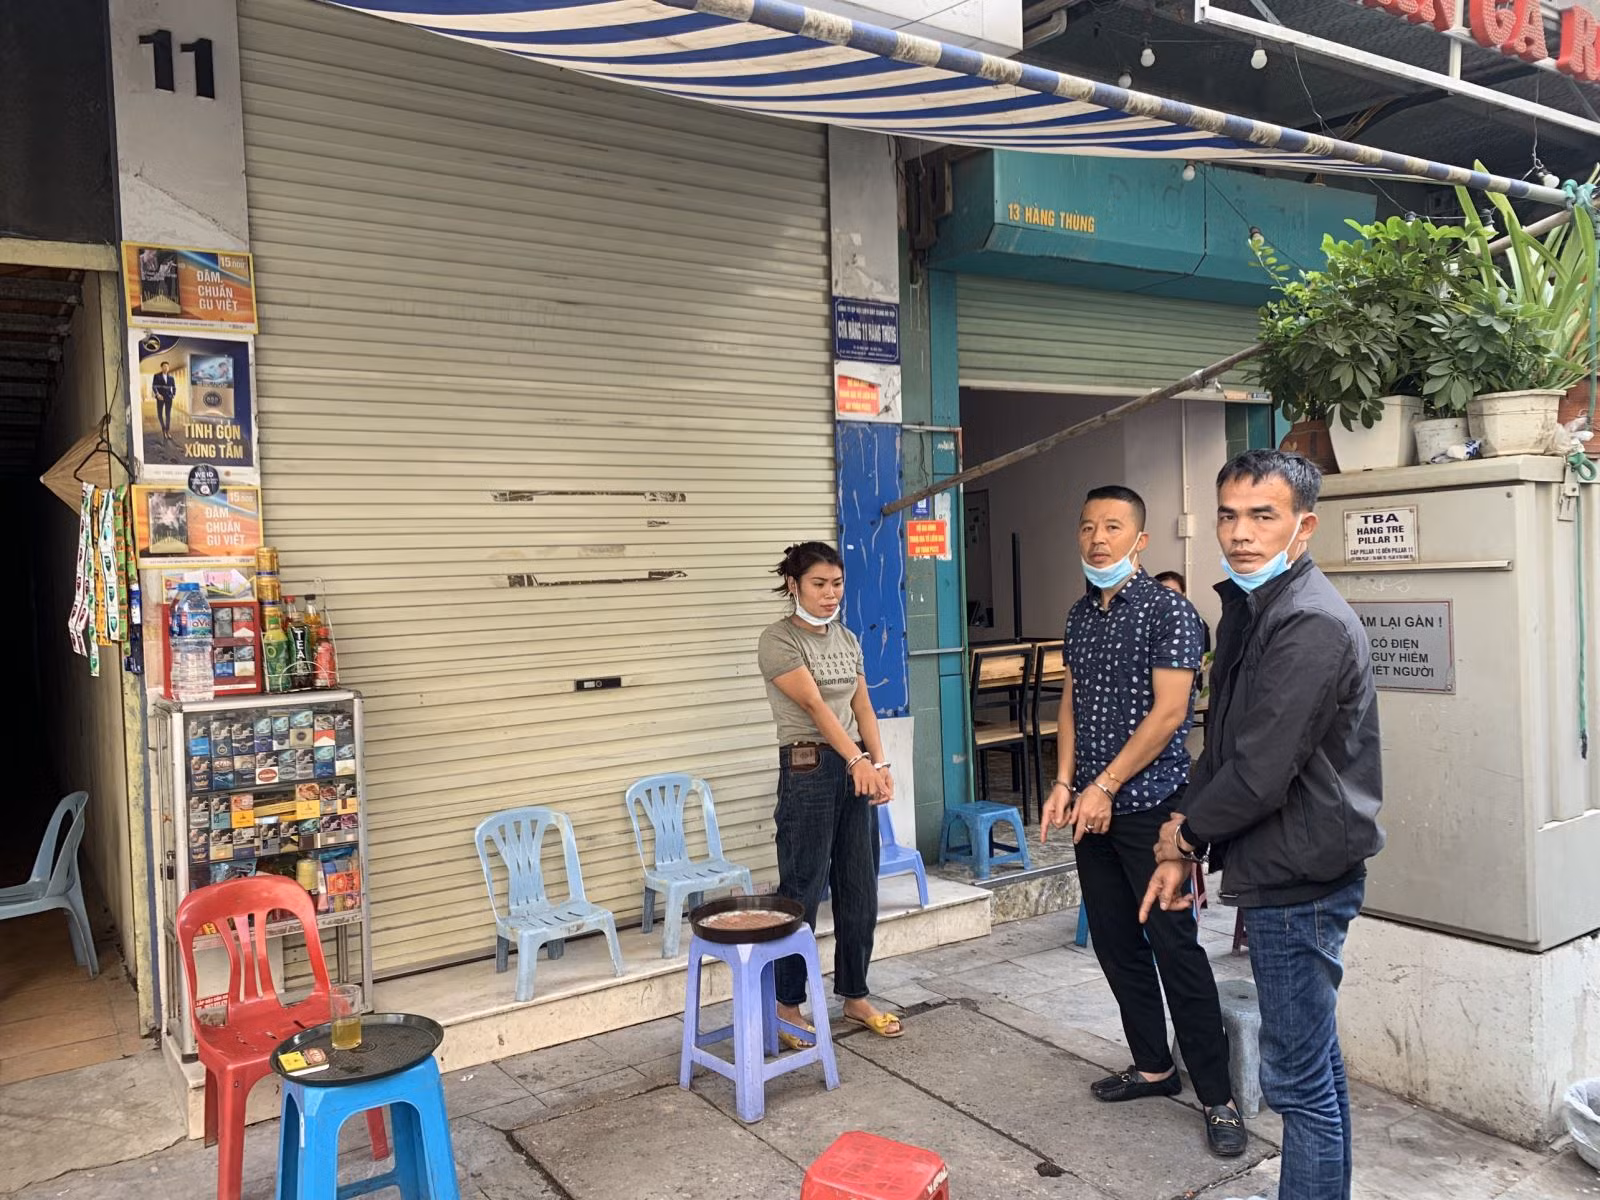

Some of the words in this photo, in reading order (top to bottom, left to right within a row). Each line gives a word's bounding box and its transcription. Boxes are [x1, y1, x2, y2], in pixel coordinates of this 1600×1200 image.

[138, 29, 215, 99] 11
[1007, 203, 1021, 221] 13
[1025, 203, 1055, 227] HÀNG
[1060, 210, 1095, 233] THÙNG
[198, 283, 233, 298] CHUẨN
[199, 299, 214, 311] GU
[216, 299, 238, 312] VIỆT
[184, 423, 213, 439] TINH
[216, 424, 241, 442] GỌN
[185, 441, 216, 458] XỨNG
[1360, 513, 1399, 524] TBA
[1387, 525, 1405, 534] TRE
[207, 535, 220, 546] GU
[1358, 536, 1390, 544] PILLAR
[1394, 535, 1404, 543] 11
[1380, 617, 1401, 630] LẠI
[1405, 614, 1434, 627] GẦN
[294, 630, 306, 659] TEA
[1371, 636, 1388, 648] CÓ
[1391, 639, 1419, 651] ĐIỆN
[1399, 651, 1429, 663] HIỂM
[1393, 665, 1434, 677] NGƯỜI
